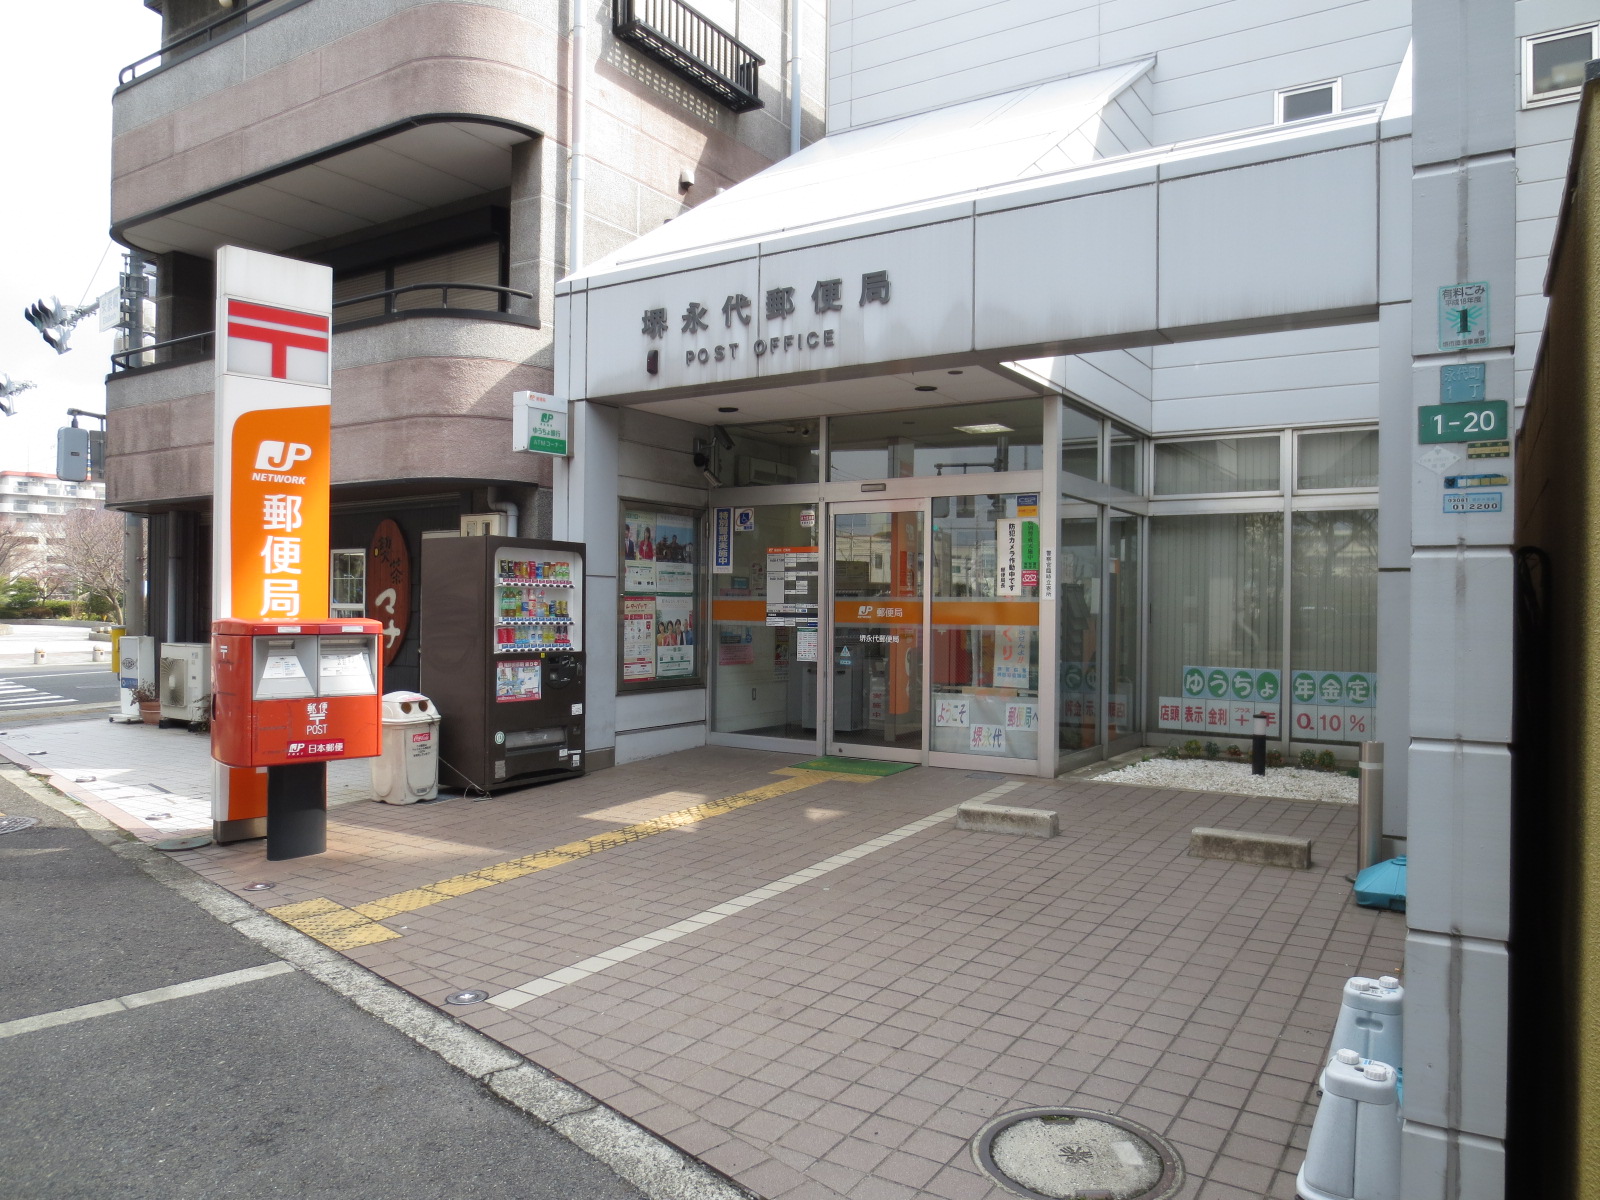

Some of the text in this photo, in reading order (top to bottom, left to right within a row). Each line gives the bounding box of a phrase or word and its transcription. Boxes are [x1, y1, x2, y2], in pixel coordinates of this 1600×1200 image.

[1442, 285, 1486, 299] 有料ごみ
[641, 269, 892, 339] 堺永代郵便局
[1445, 296, 1482, 306] 平成18年度
[1456, 308, 1471, 334] 1
[685, 329, 836, 366] POST OFFICE
[1444, 365, 1481, 382] 永代町
[1433, 410, 1495, 435] 1-20
[532, 427, 561, 437] ゆうちょ銀行
[254, 440, 312, 472] JP
[252, 472, 307, 485] NETWORK
[260, 493, 303, 617] 郵便局
[1008, 523, 1016, 591] 防犯カメラ作動中です
[876, 608, 903, 617] 郵便局
[859, 634, 900, 643] 堺永代郵便局
[1185, 671, 1275, 698] ゆうちょ
[306, 702, 328, 715] 郵便
[306, 724, 328, 735] POST
[308, 743, 344, 754] 日本郵便
